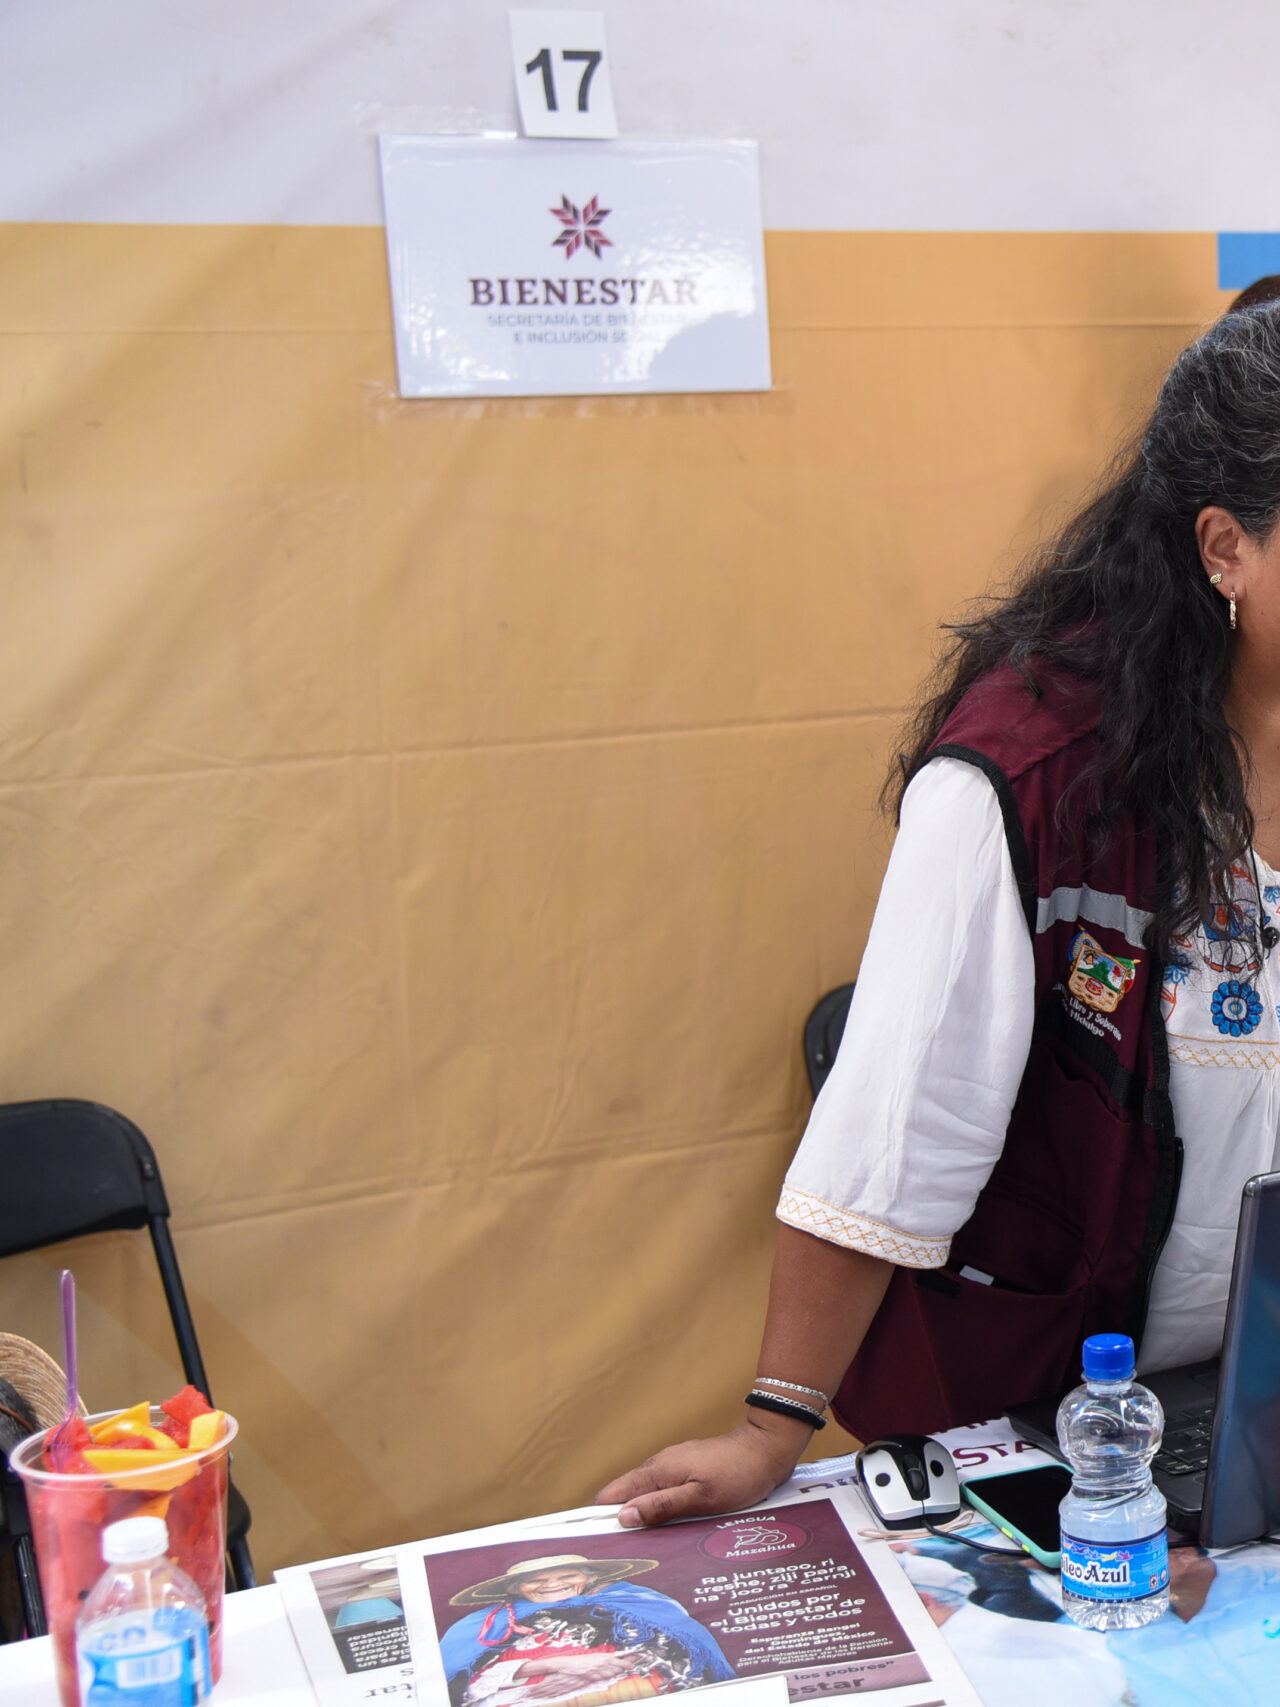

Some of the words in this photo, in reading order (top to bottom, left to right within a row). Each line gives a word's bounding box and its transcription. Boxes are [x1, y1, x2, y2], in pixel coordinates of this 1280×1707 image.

[525, 47, 603, 113] 17
[469, 277, 699, 306] BIENESTAR
[487, 311, 579, 328] SECRETARÍA
[583, 313, 601, 327] DE
[513, 331, 523, 345] E
[527, 328, 608, 345] INCLUSIÓN
[1087, 1011, 1094, 1021] y
[716, 1516, 776, 1529] LENGUA
[725, 1543, 796, 1558] Mazahua
[694, 1579, 766, 1594] treshe,
[770, 1572, 798, 1584] ziji
[804, 1565, 848, 1578] para
[702, 1576, 728, 1585] Ra
[732, 1563, 816, 1582] juntaoo,
[821, 1558, 834, 1567] ri
[1084, 1563, 1127, 1583] Azul
[731, 1587, 763, 1599] joo
[801, 1569, 856, 1584] carnji
[710, 1618, 728, 1627] el
[734, 1603, 833, 1624] Bienestar
[840, 1598, 866, 1608] de
[728, 1600, 801, 1616] Unidos
[806, 1592, 840, 1605] por
[721, 1621, 781, 1633] todas
[785, 1618, 798, 1627] y
[803, 1607, 862, 1621] todos
[347, 1626, 407, 1642] ienestar
[751, 1631, 815, 1643] Esperanza
[817, 1623, 860, 1634] Rangel
[768, 1642, 811, 1651] Estado
[832, 1631, 876, 1642] México
[355, 1651, 387, 1663] para
[772, 1652, 817, 1661] Bienestar
[850, 1641, 894, 1650] Personas
[817, 1650, 857, 1659] Mayores
[794, 1671, 820, 1681] los
